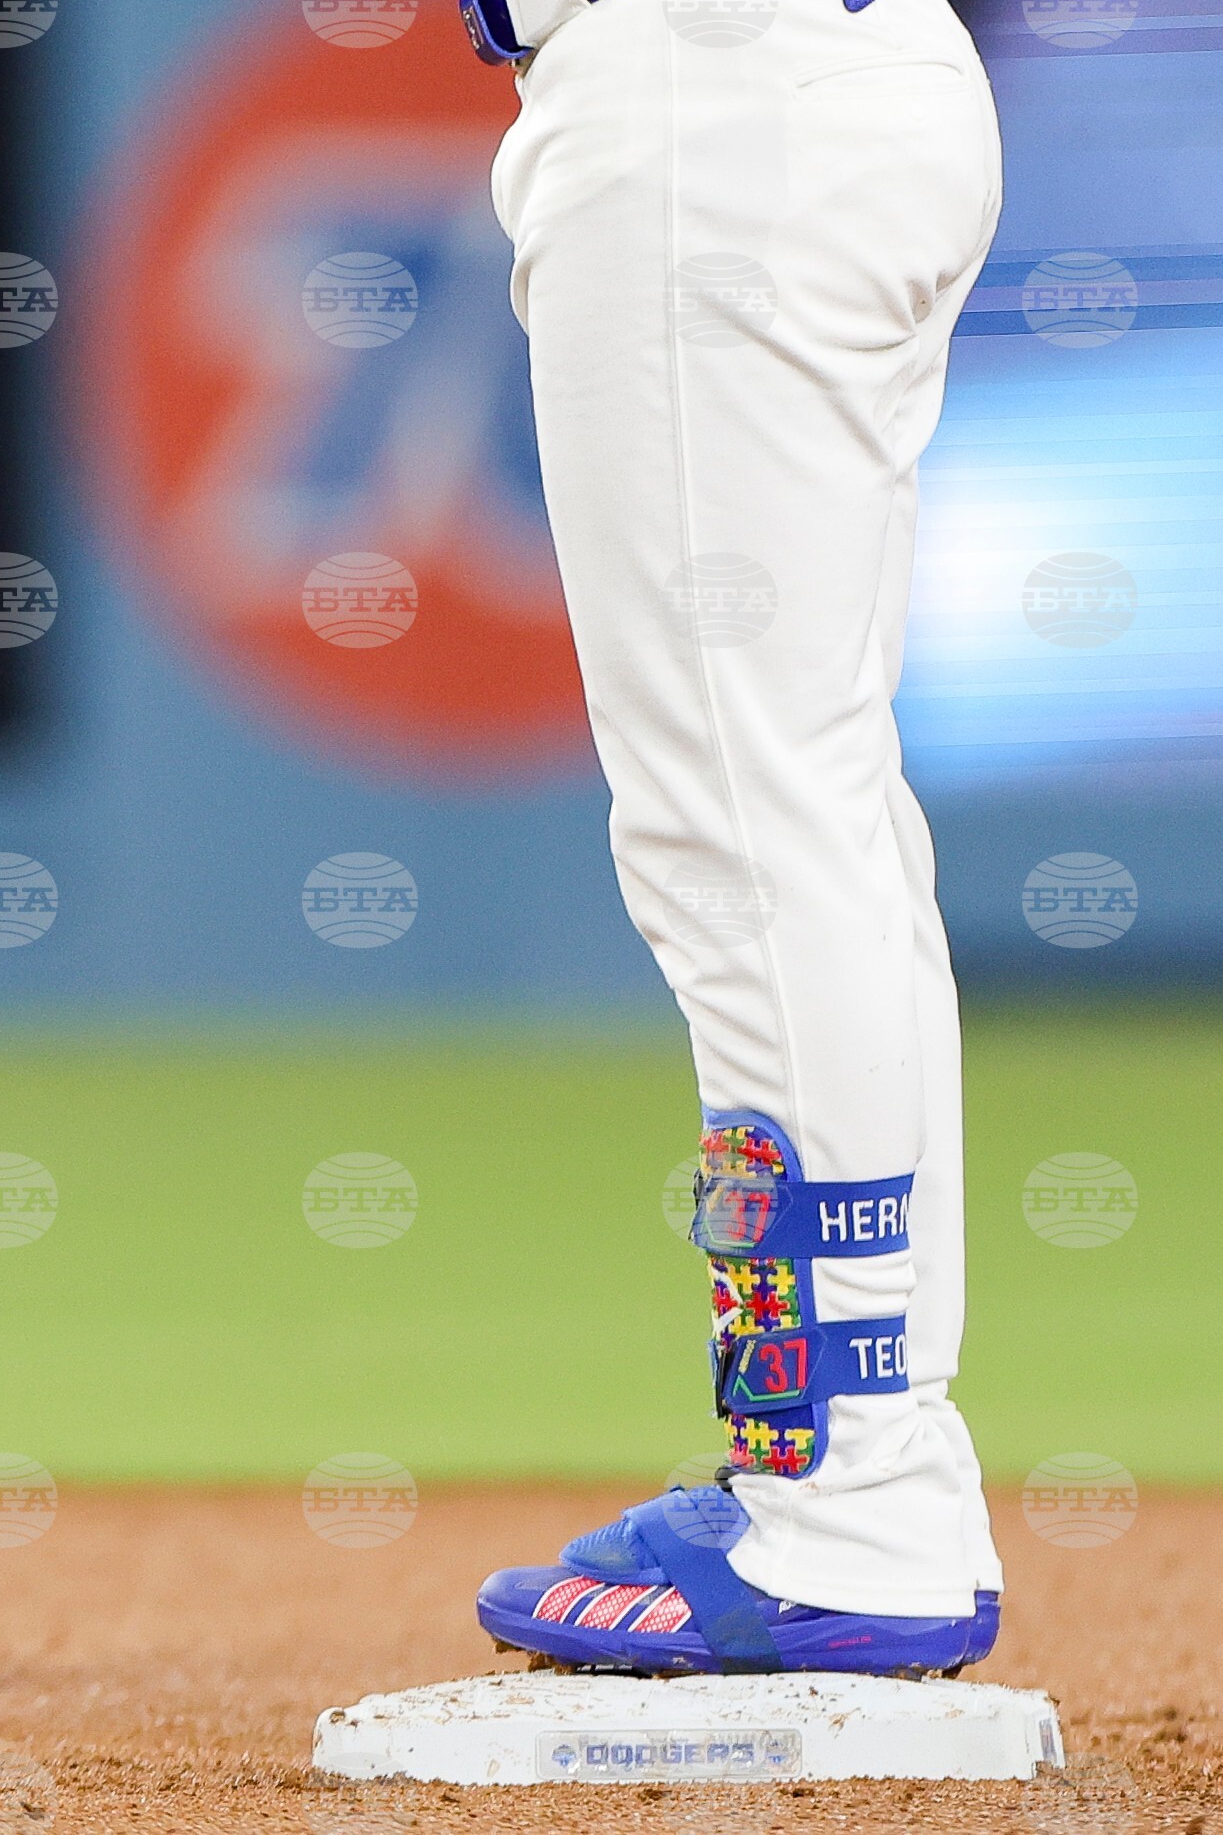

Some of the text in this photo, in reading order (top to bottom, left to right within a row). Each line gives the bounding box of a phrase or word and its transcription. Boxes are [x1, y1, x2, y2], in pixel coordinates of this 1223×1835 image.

[724, 1190, 771, 1243] 37
[759, 1337, 808, 1394] 37
[849, 1333, 907, 1380] TEO
[586, 1742, 755, 1767] DODGERS
